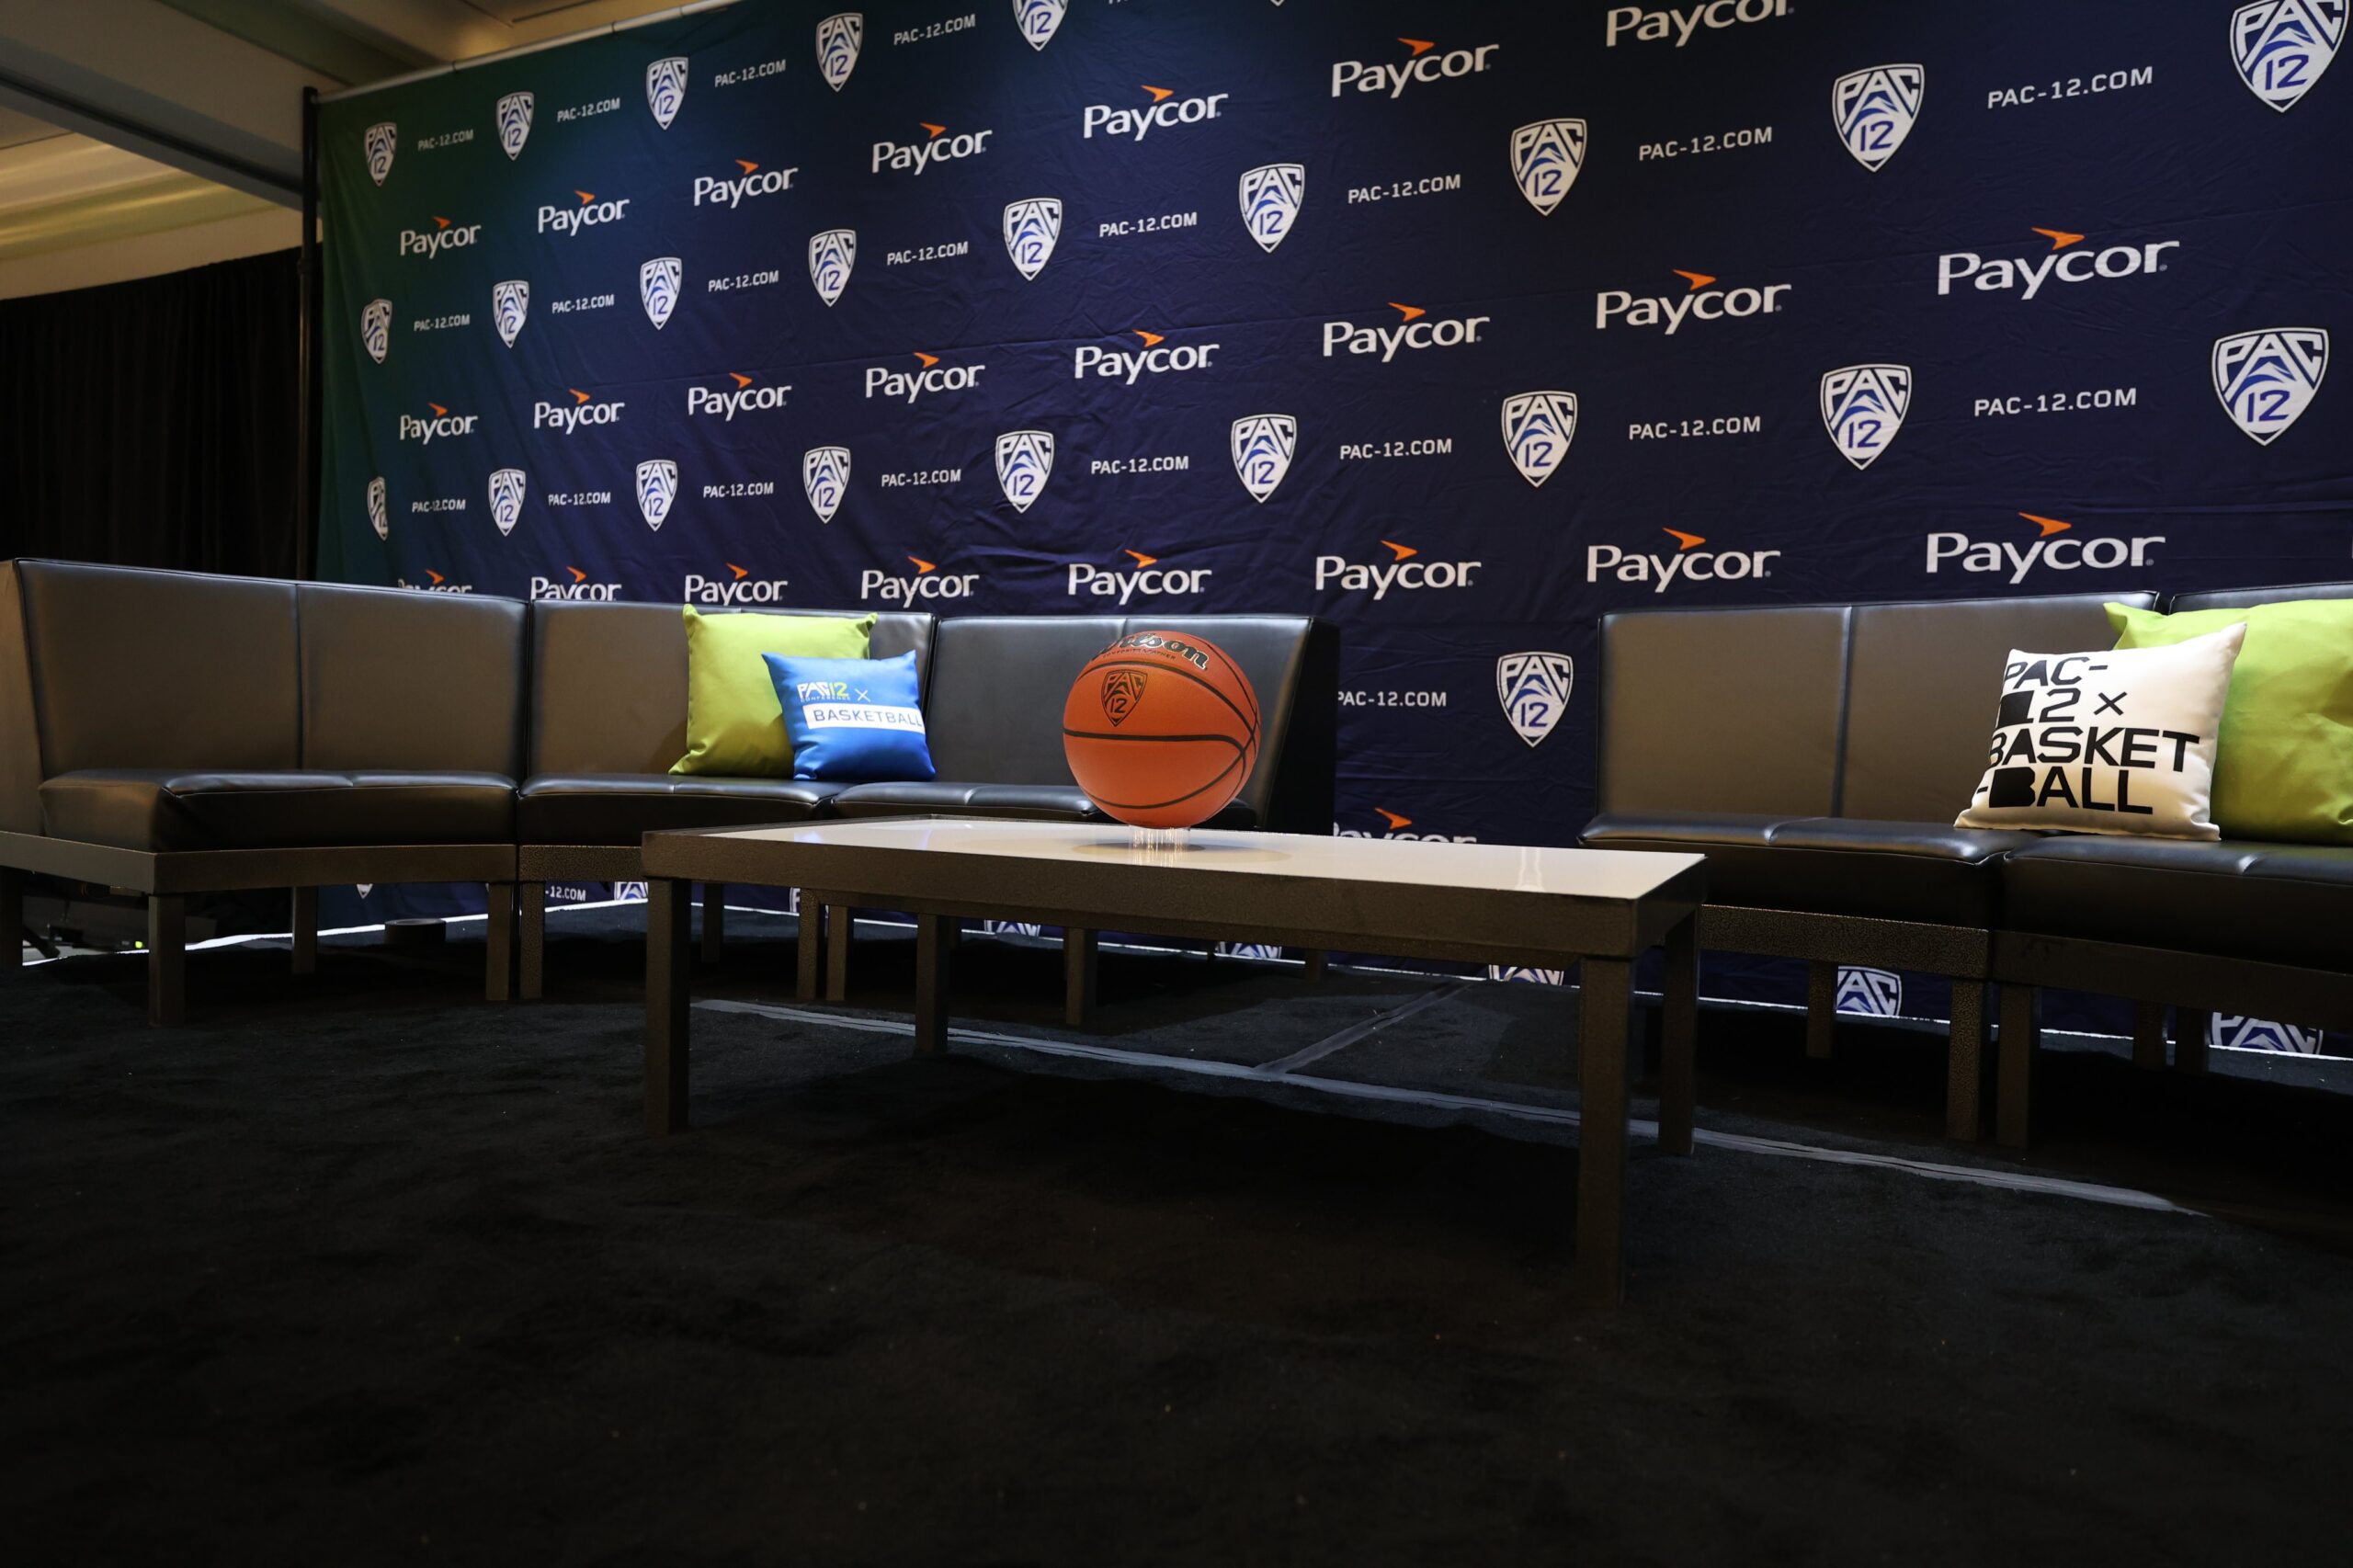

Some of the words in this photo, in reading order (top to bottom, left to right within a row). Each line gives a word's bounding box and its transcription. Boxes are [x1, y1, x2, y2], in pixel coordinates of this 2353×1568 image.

[819, 17, 860, 62] PAC
[894, 14, 975, 45] PAC-12.COM
[1030, 12, 1051, 35] 12
[2235, 0, 2344, 73] PAC
[715, 59, 786, 87] PAC-12.COM
[831, 54, 847, 77] 12
[1332, 44, 1499, 98] Paycor
[2265, 54, 2309, 90] 12
[649, 61, 686, 103] PAC
[1988, 66, 2153, 108] PAC-12.COM
[499, 95, 532, 135] PAC
[557, 97, 620, 122] PAC-12.COM
[659, 95, 675, 116] 12
[1838, 68, 1919, 131] PAC
[1084, 93, 1229, 142] Paycor
[418, 129, 474, 150] PAC-12.COM
[508, 128, 521, 148] 12
[1515, 123, 1583, 180] PAC
[1639, 127, 1772, 161] PAC-12.COM
[1860, 120, 1894, 152] 12
[872, 130, 993, 176] Paycor
[694, 167, 799, 209] Paycor
[1244, 167, 1302, 220] PAC
[1348, 174, 1461, 204] PAC-12.COM
[1534, 170, 1562, 198] 12
[538, 199, 630, 236] Paycor
[1006, 201, 1059, 250] PAC
[1099, 211, 1197, 237] PAC-12.COM
[1259, 210, 1283, 236] 12
[401, 225, 482, 259] Paycor
[812, 233, 854, 278] PAC
[887, 241, 968, 266] PAC-12.COM
[1021, 242, 1043, 266] 12
[642, 261, 679, 303] PAC
[709, 270, 779, 292] PAC-12.COM
[824, 270, 841, 292] 12
[1938, 241, 2179, 300] Paycor
[495, 283, 528, 324] PAC
[552, 294, 614, 313] PAC-12.COM
[653, 295, 668, 316] 12
[1597, 284, 1791, 335] Paycor
[413, 313, 471, 332] PAC-12.COM
[504, 316, 517, 335] 12
[1323, 316, 1490, 362] Paycor
[1074, 344, 1220, 385] Paycor
[2219, 333, 2322, 402] PAC
[866, 365, 985, 403] Paycor
[1825, 369, 1906, 431] PAC
[534, 395, 625, 435] Paycor
[688, 385, 791, 421] Paycor
[1974, 388, 2136, 416] PAC-12.COM
[2247, 390, 2290, 423] 12
[400, 415, 478, 445] Paycor
[1506, 395, 1573, 451] PAC
[1629, 415, 1760, 440] PAC-12.COM
[1847, 420, 1881, 450] 12
[999, 434, 1051, 483] PAC
[1235, 417, 1293, 471] PAC
[1340, 438, 1451, 460] PAC-12.COM
[1524, 441, 1552, 469] 12
[806, 449, 848, 495] PAC
[881, 469, 961, 487] PAC-12.COM
[1091, 456, 1188, 474] PAC-12.COM
[1251, 460, 1275, 486] 12
[491, 472, 524, 512] PAC
[548, 492, 610, 506] PAC-12.COM
[639, 463, 675, 505] PAC
[703, 482, 774, 498] PAC-12.COM
[818, 487, 835, 509] 12
[1014, 474, 1035, 498] 12
[411, 498, 467, 514] PAC-12.COM
[500, 505, 513, 524] 12
[649, 497, 664, 517] 12
[1587, 545, 1781, 593] Paycor
[1927, 532, 2165, 584] Paycor
[685, 574, 788, 606] Paycor
[861, 570, 980, 608] Paycor
[1068, 563, 1212, 605] Paycor
[1315, 556, 1482, 600] Paycor
[1105, 672, 1146, 703] PAC
[1501, 656, 1569, 712] PAC
[2005, 657, 2108, 689] PAC-
[813, 710, 922, 727] BASKETBALL
[1110, 699, 1127, 713] 12
[1520, 702, 1548, 729] 12
[1990, 727, 2200, 772] BASKET
[545, 888, 586, 902] -12.COM
[1838, 971, 1897, 1017] AC
